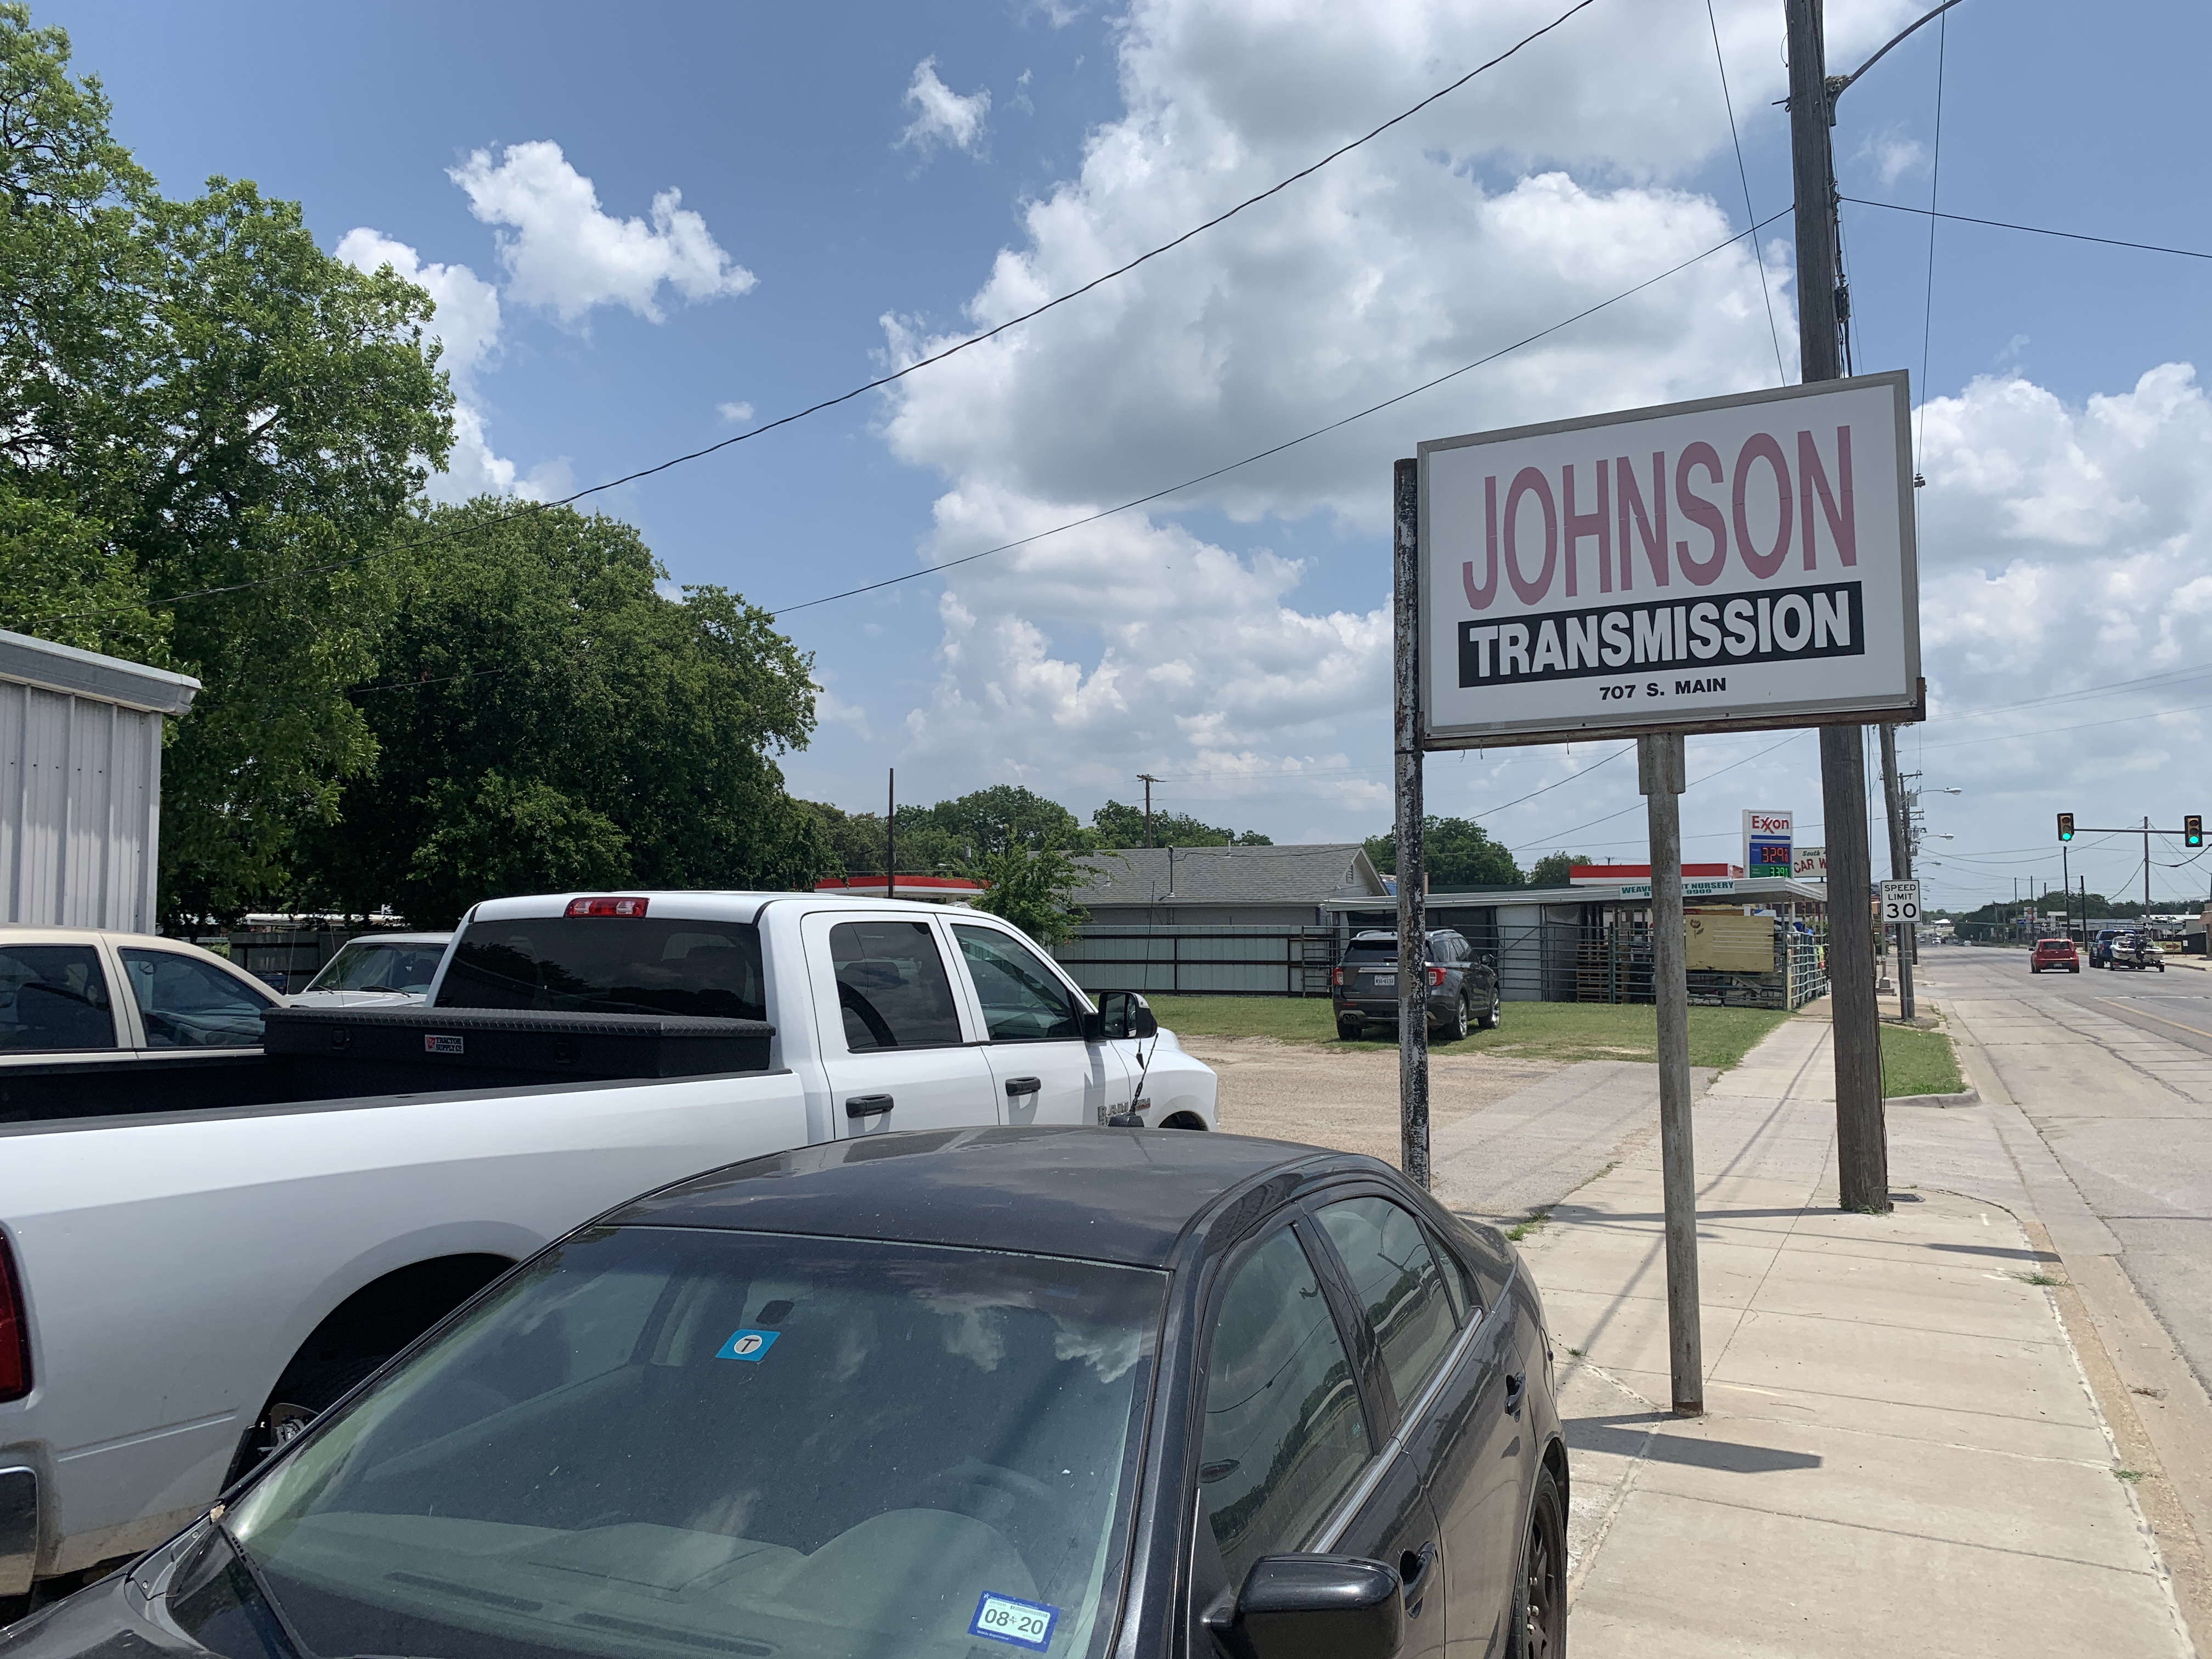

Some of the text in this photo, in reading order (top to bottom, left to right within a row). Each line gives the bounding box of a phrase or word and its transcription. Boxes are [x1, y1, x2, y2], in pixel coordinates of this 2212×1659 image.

[1462, 425, 1857, 610] JOHNSON
[1469, 590, 1851, 678] TRANSMISSION
[1599, 678, 1726, 700] 707 S. MAIN
[1752, 815, 1790, 834] Exxon
[1793, 859, 1814, 873] CAR
[1887, 903, 1916, 918] 30
[741, 1338, 760, 1352] T
[985, 1609, 1044, 1635] 08 20
